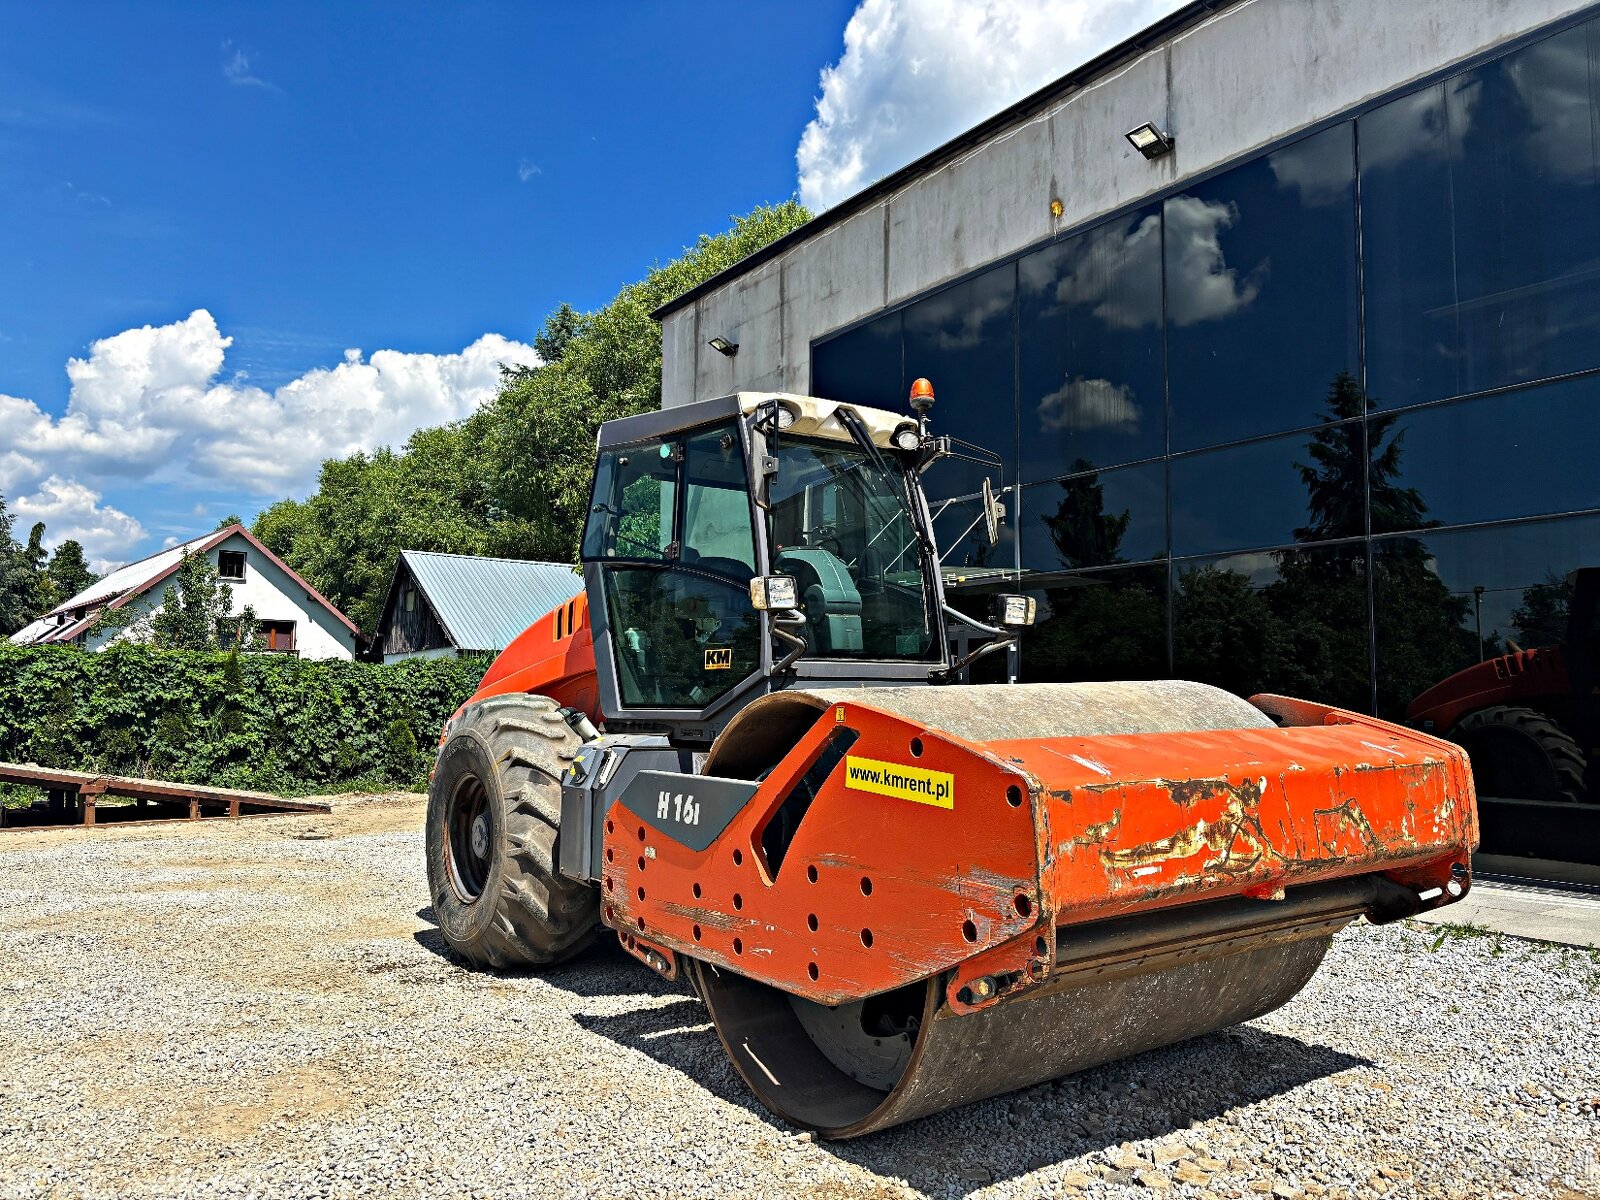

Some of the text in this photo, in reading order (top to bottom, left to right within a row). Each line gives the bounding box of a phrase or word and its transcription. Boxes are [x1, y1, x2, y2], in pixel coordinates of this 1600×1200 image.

[705, 650, 730, 664] KM
[849, 766, 949, 801] www.kmrent.pl
[656, 791, 670, 820] H
